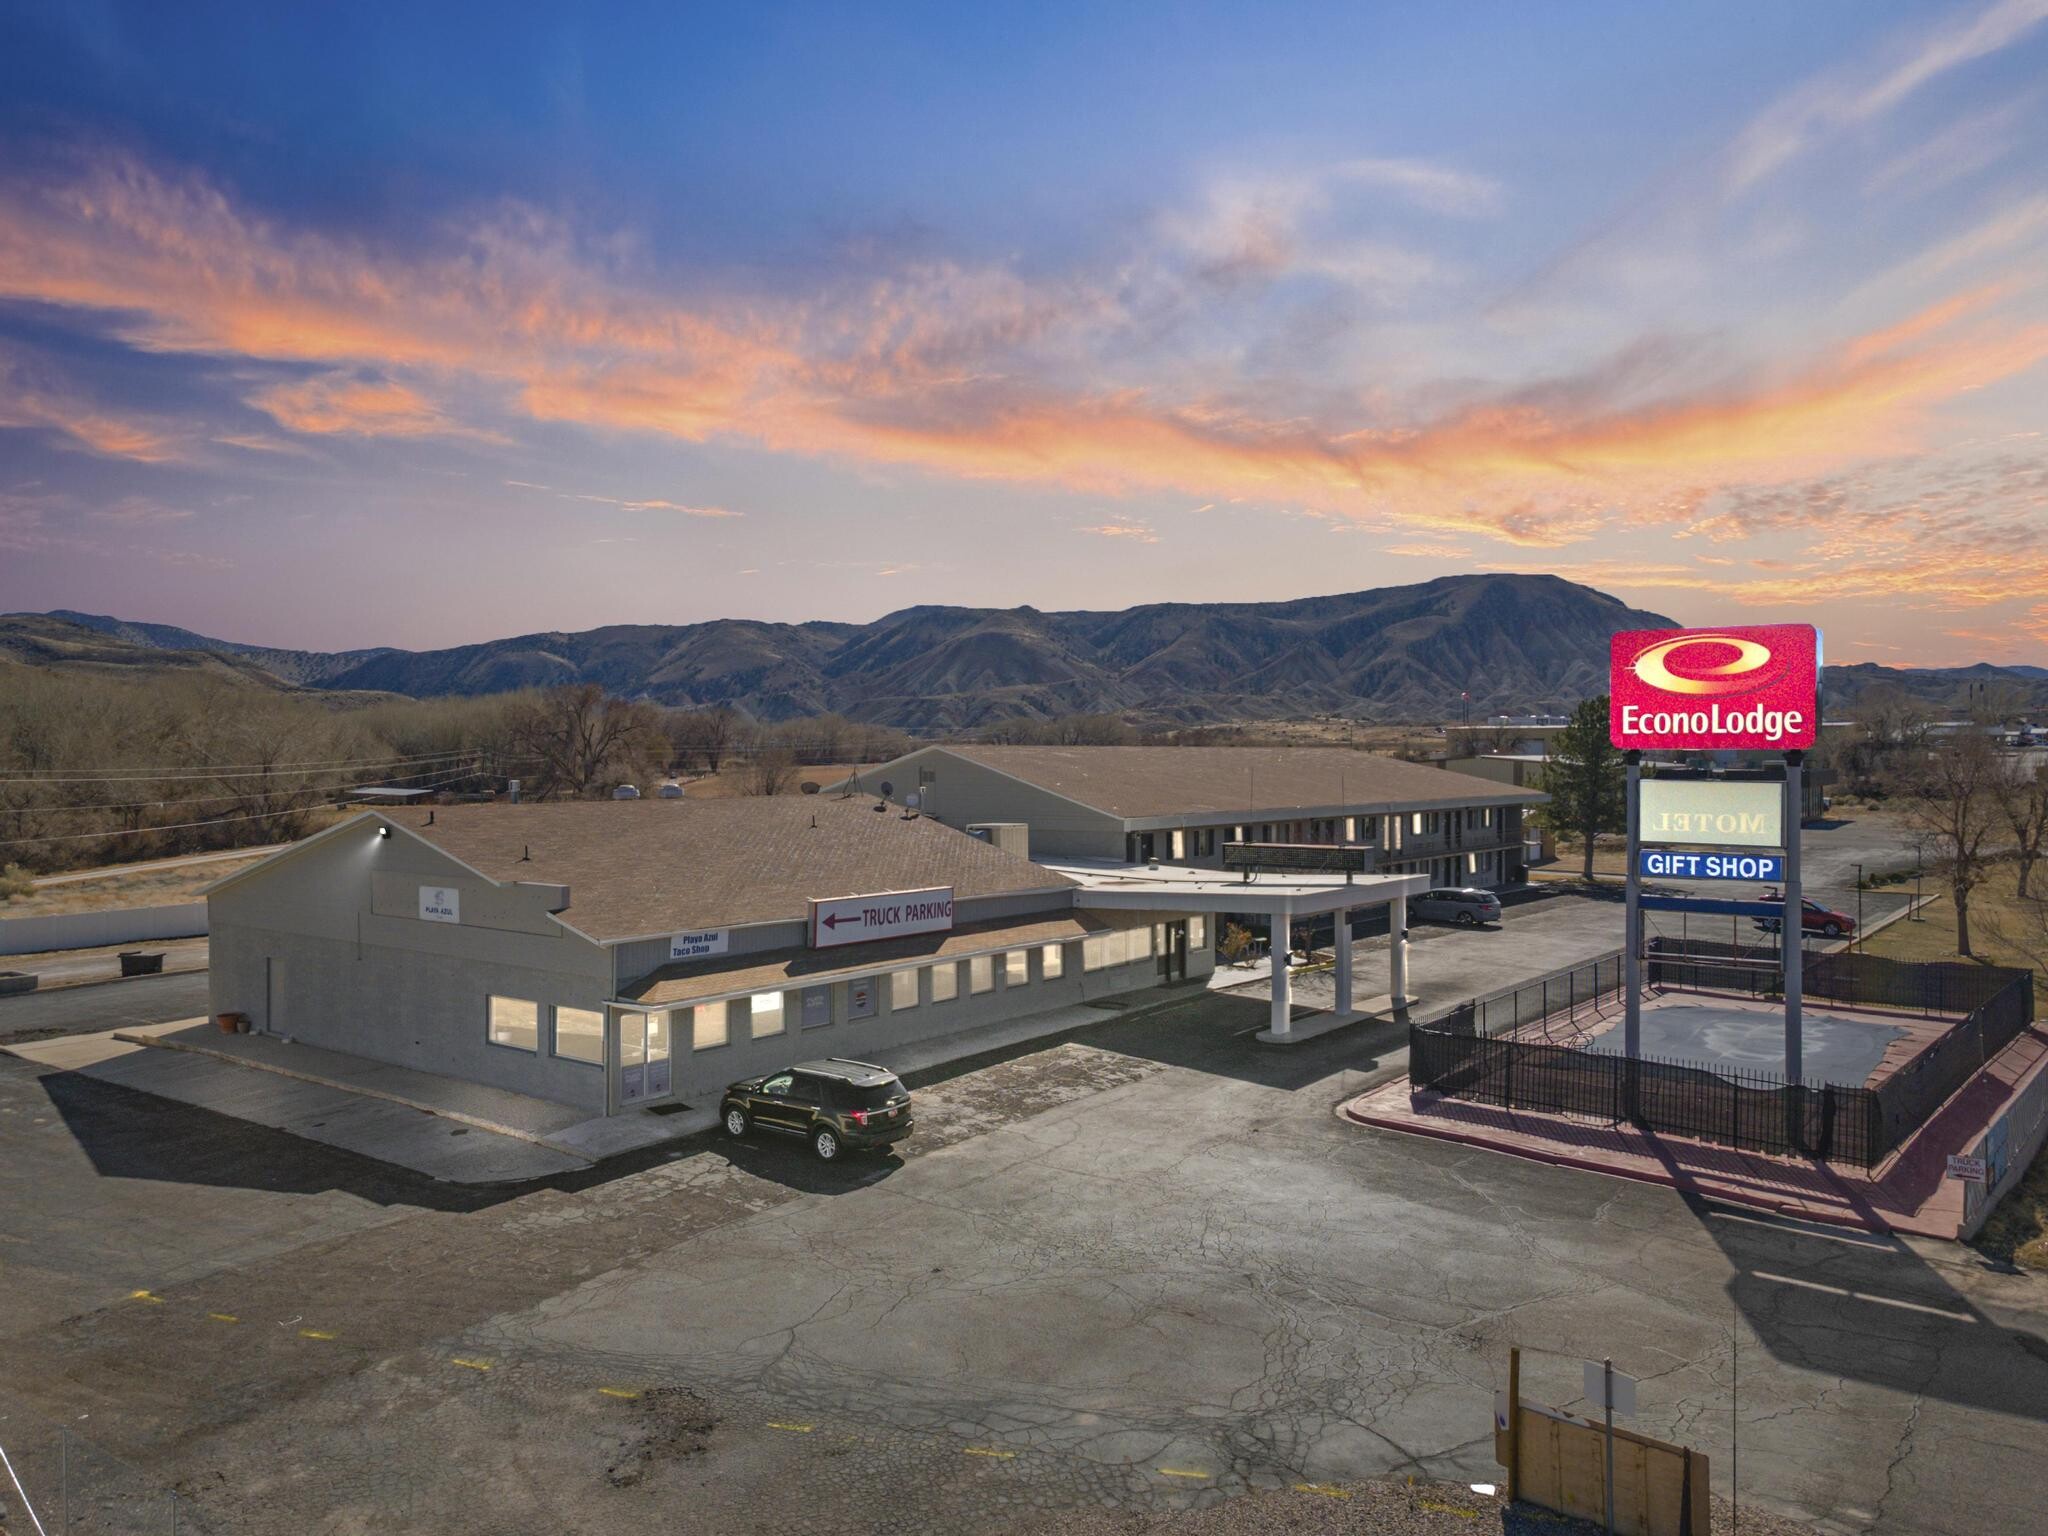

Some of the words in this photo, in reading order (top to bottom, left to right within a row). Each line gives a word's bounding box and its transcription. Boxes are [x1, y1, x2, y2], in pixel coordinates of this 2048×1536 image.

[1647, 854, 1700, 876] GIFT
[1706, 857, 1774, 878] SHOP
[863, 906, 901, 927] TRUCK
[905, 901, 952, 922] PARKING
[703, 932, 719, 943] Azul
[673, 947, 691, 957] Taco
[691, 945, 710, 955] Shop
[1952, 1157, 1981, 1167] TRUCK
[1948, 1164, 1984, 1175] PARKING
